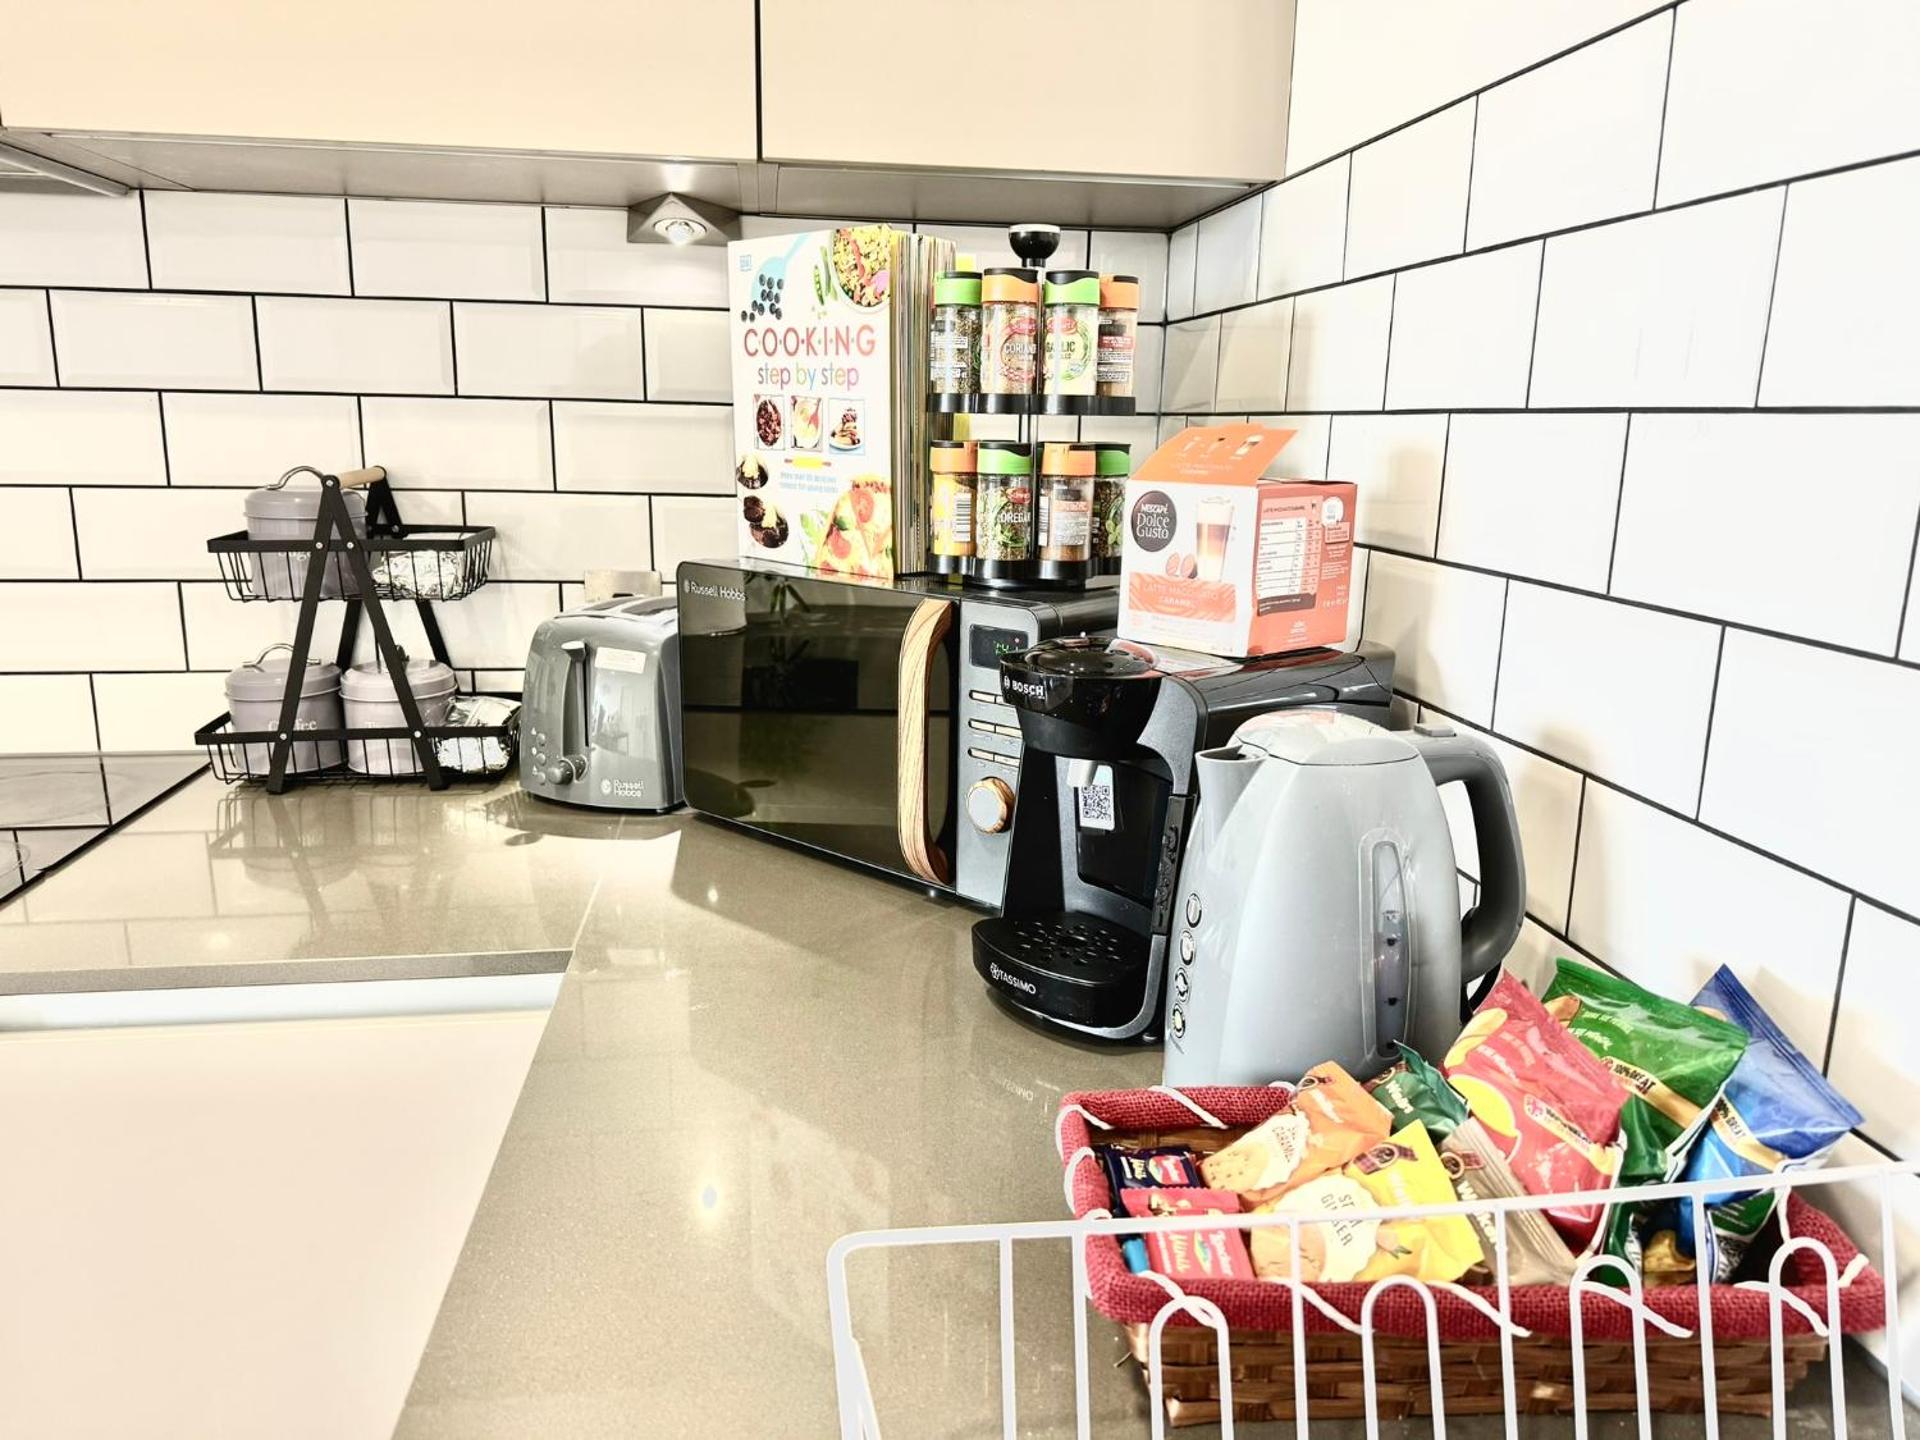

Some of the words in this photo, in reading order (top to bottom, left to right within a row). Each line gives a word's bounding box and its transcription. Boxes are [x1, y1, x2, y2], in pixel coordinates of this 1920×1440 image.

[757, 362, 791, 390] step
[796, 362, 817, 391] by
[821, 362, 860, 391] step
[1137, 512, 1170, 528] Dolce
[1136, 526, 1170, 539] Gusto
[690, 581, 719, 597] Russell
[720, 586, 746, 601] Hobbs
[1012, 680, 1044, 696] BOSCH
[999, 969, 1037, 995] TASSIMO
